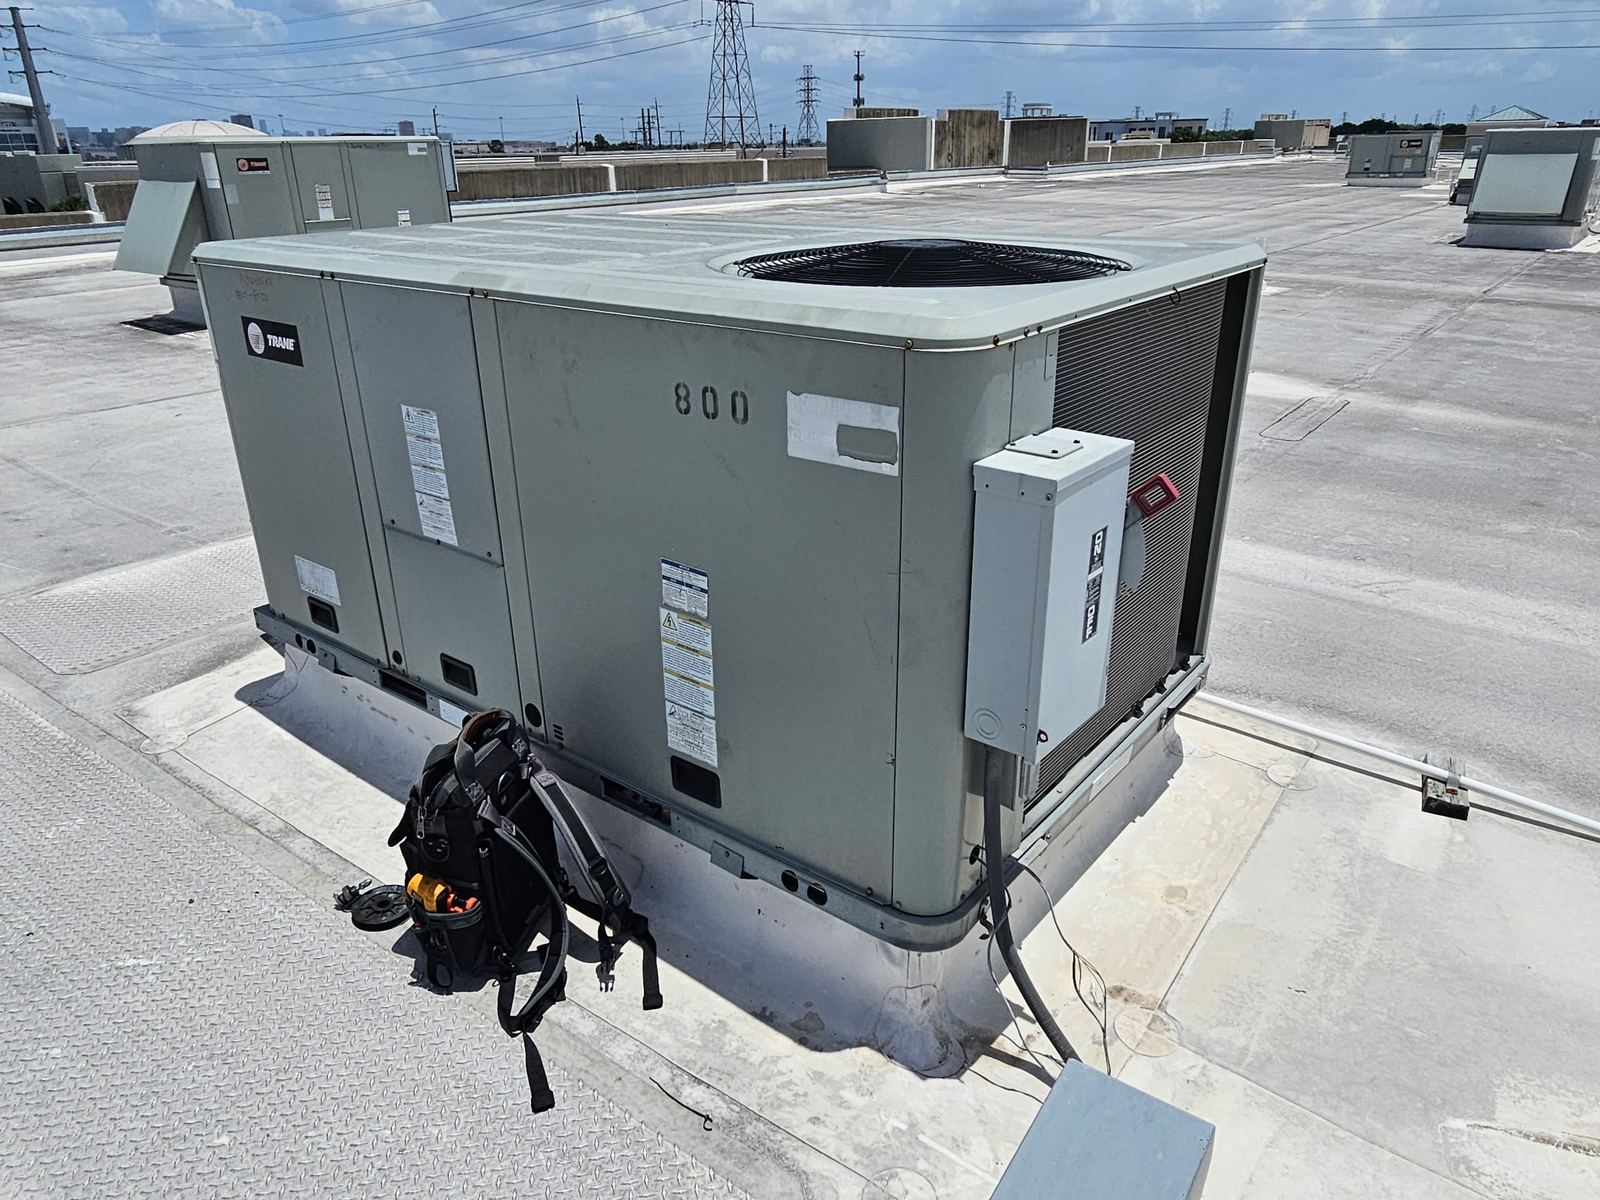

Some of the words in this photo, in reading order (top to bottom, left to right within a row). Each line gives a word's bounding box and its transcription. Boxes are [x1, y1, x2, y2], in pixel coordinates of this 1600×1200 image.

[266, 333, 295, 351] TRANE
[674, 381, 749, 426] 800
[1093, 530, 1104, 556] ON
[1085, 604, 1096, 639] OFF
